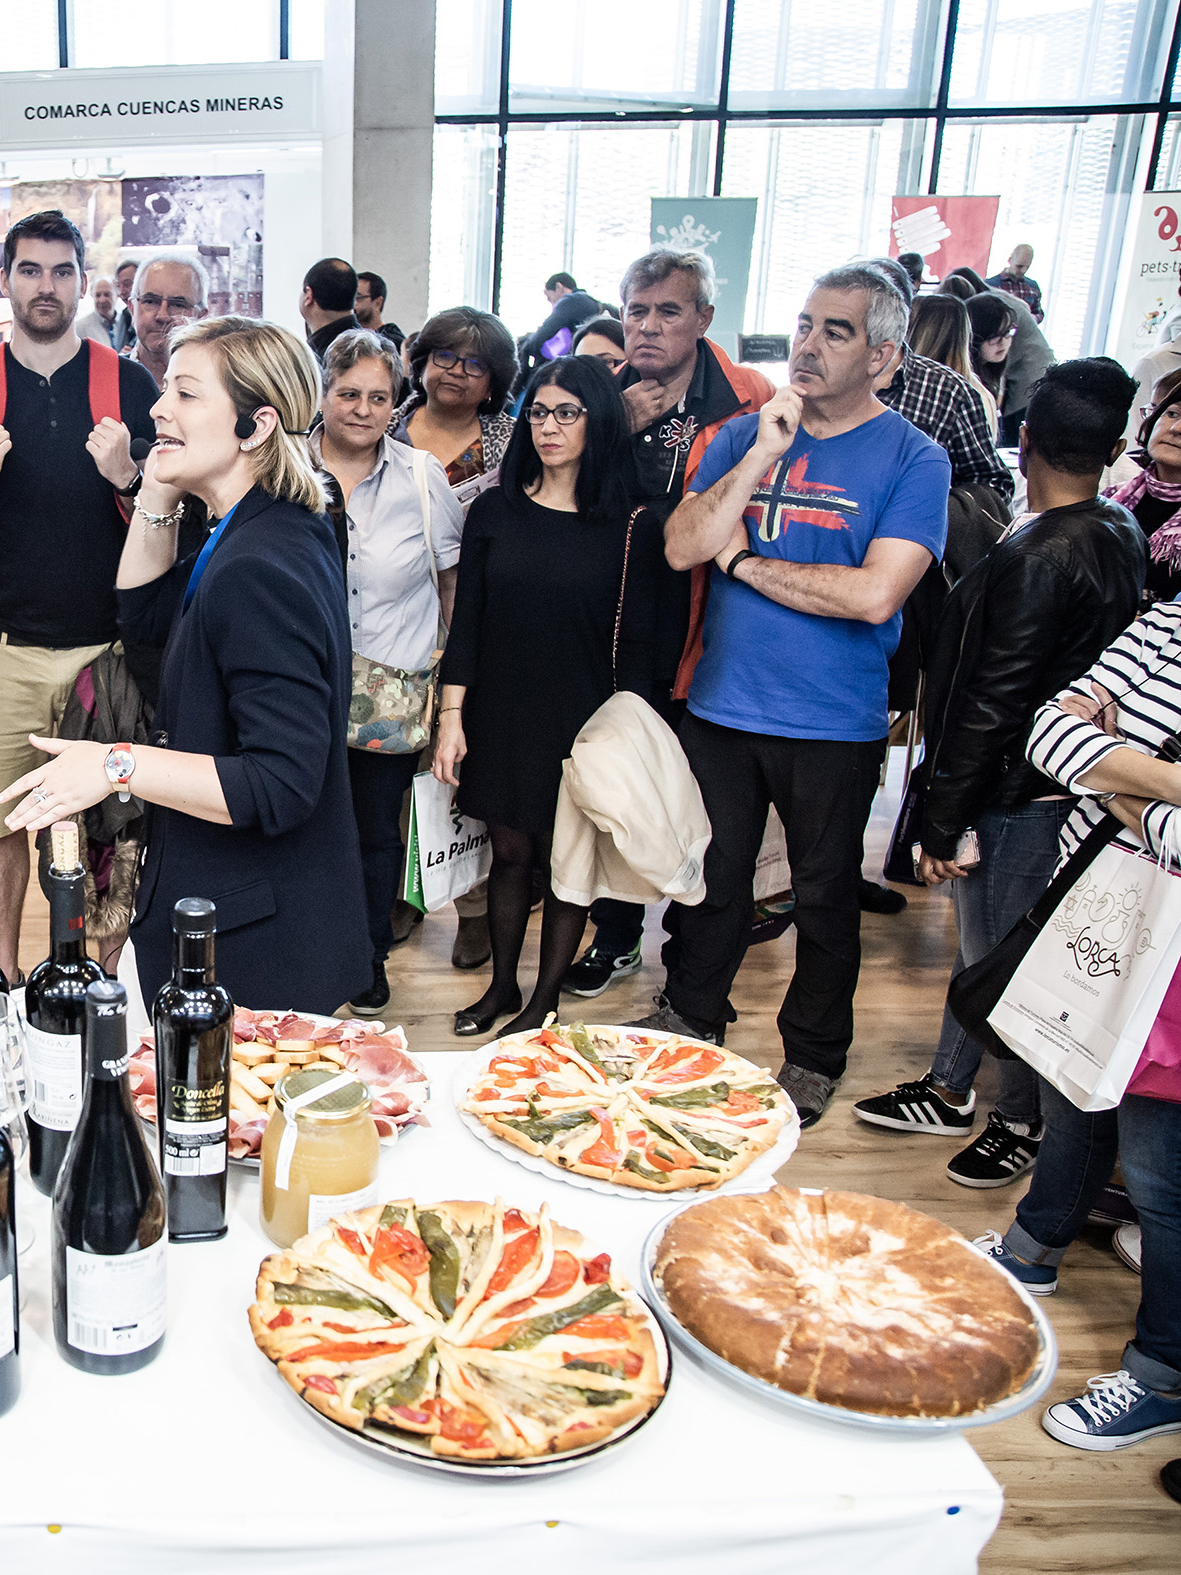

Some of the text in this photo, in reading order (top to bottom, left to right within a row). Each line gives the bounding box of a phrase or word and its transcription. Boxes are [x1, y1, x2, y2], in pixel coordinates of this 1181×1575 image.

[24, 96, 284, 120] COMARCA CUENCAS MINERAS
[426, 851, 444, 868] La
[1066, 926, 1121, 977] LORCA
[1072, 972, 1101, 998] bordamos
[172, 1080, 225, 1099] Doncella
[179, 1147, 189, 1157] ml
